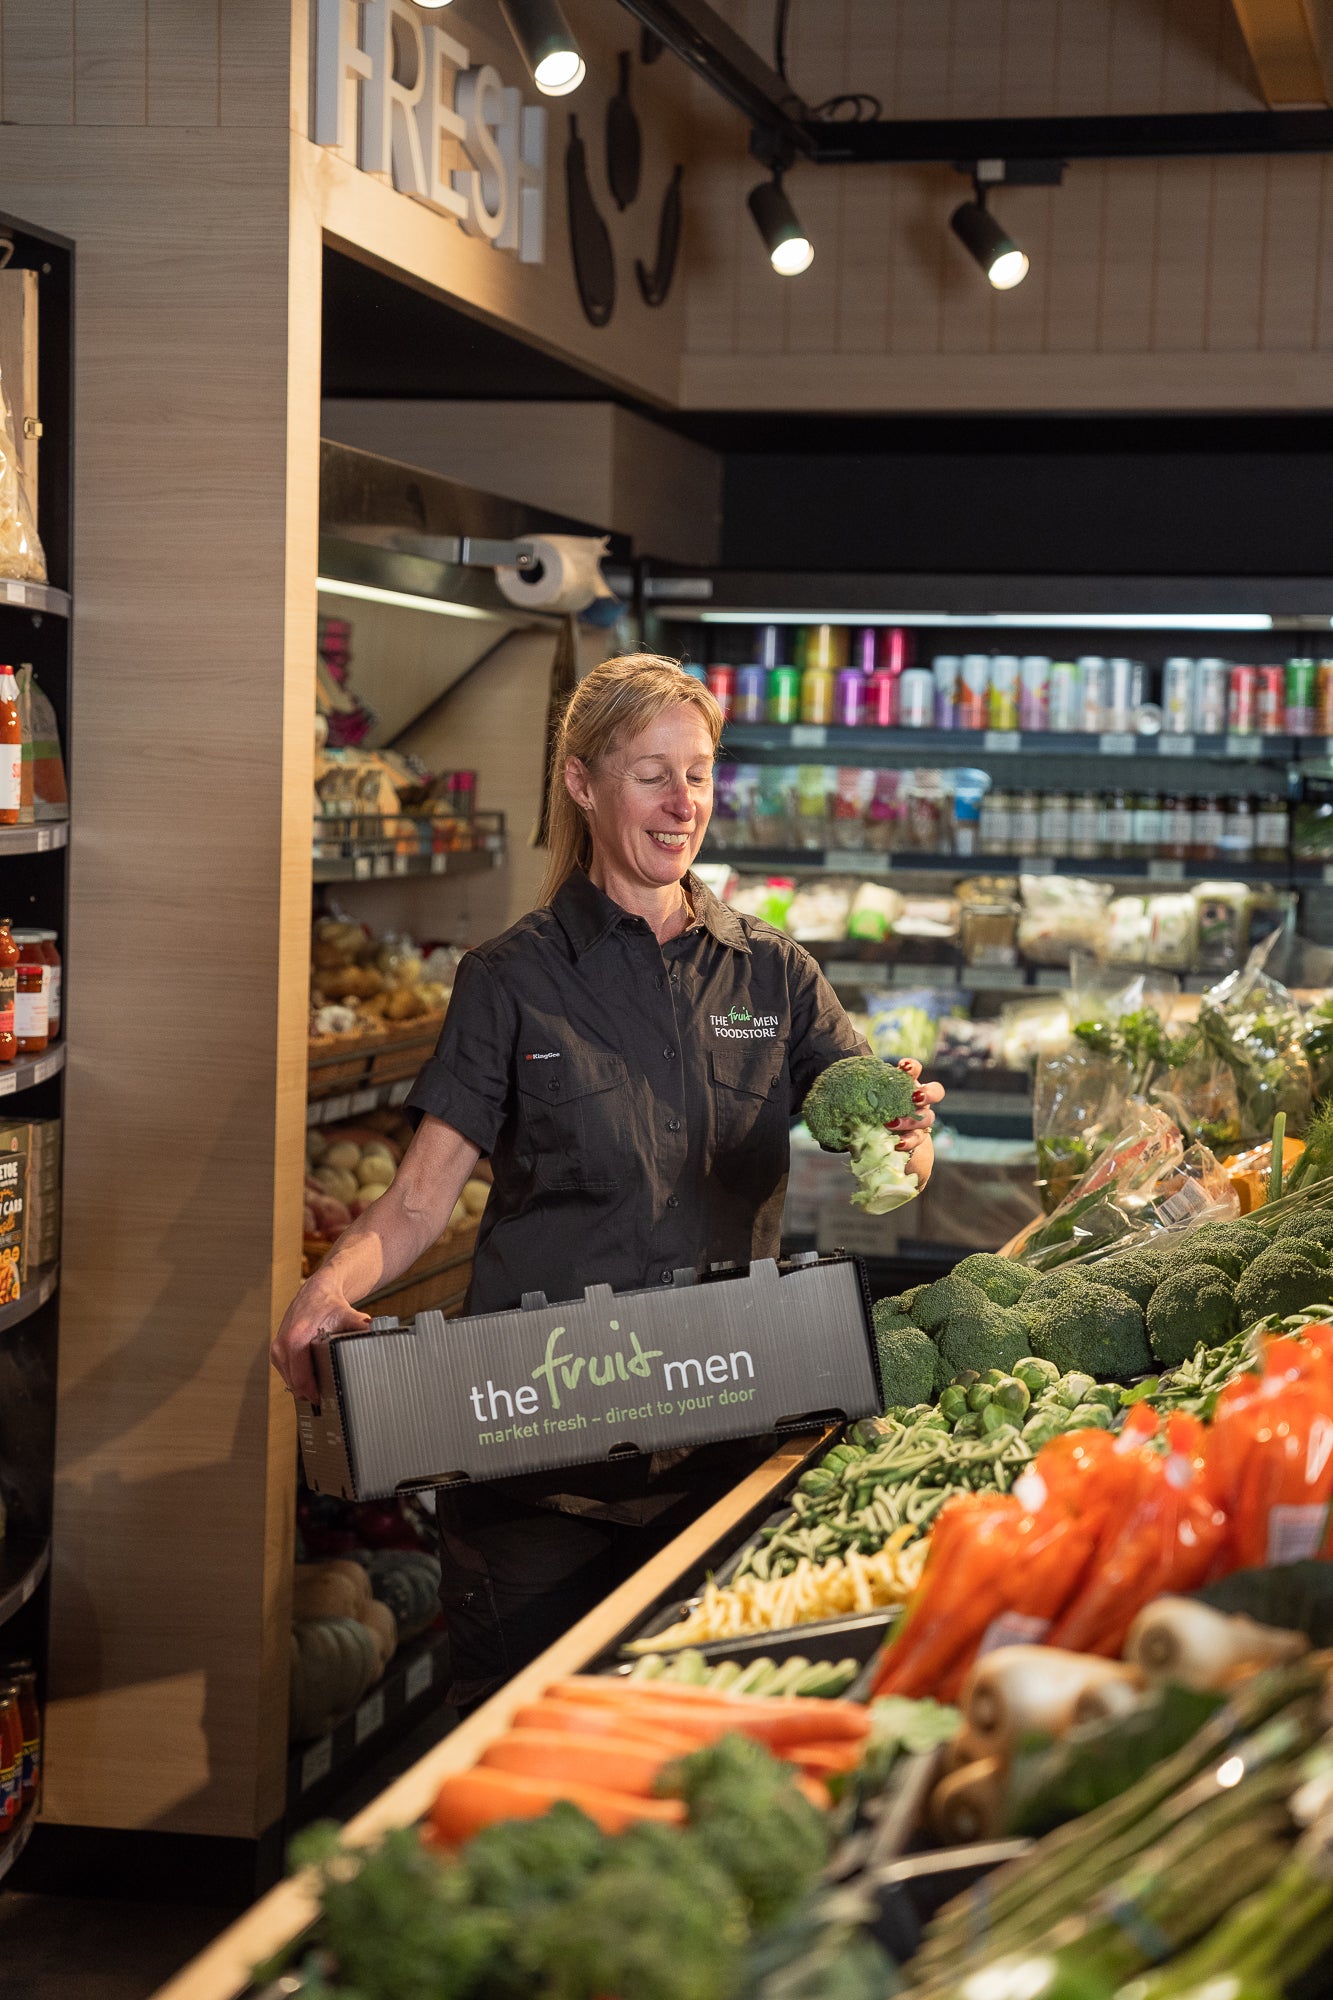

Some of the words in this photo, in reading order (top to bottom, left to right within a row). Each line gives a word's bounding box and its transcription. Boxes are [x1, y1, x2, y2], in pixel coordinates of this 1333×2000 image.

[314, 0, 547, 264] FRESH
[710, 1015, 729, 1026] THE
[728, 1005, 753, 1025] fruit
[753, 1015, 779, 1027] MEN
[714, 1027, 777, 1039] FOODSTORE
[469, 1380, 539, 1423] the
[531, 1319, 664, 1410] fruit
[663, 1349, 755, 1392] men
[478, 1421, 540, 1446] market
[542, 1413, 588, 1435] fresh
[606, 1405, 654, 1425] direct
[657, 1401, 674, 1415] to
[677, 1396, 714, 1417] your
[718, 1388, 757, 1406] door
